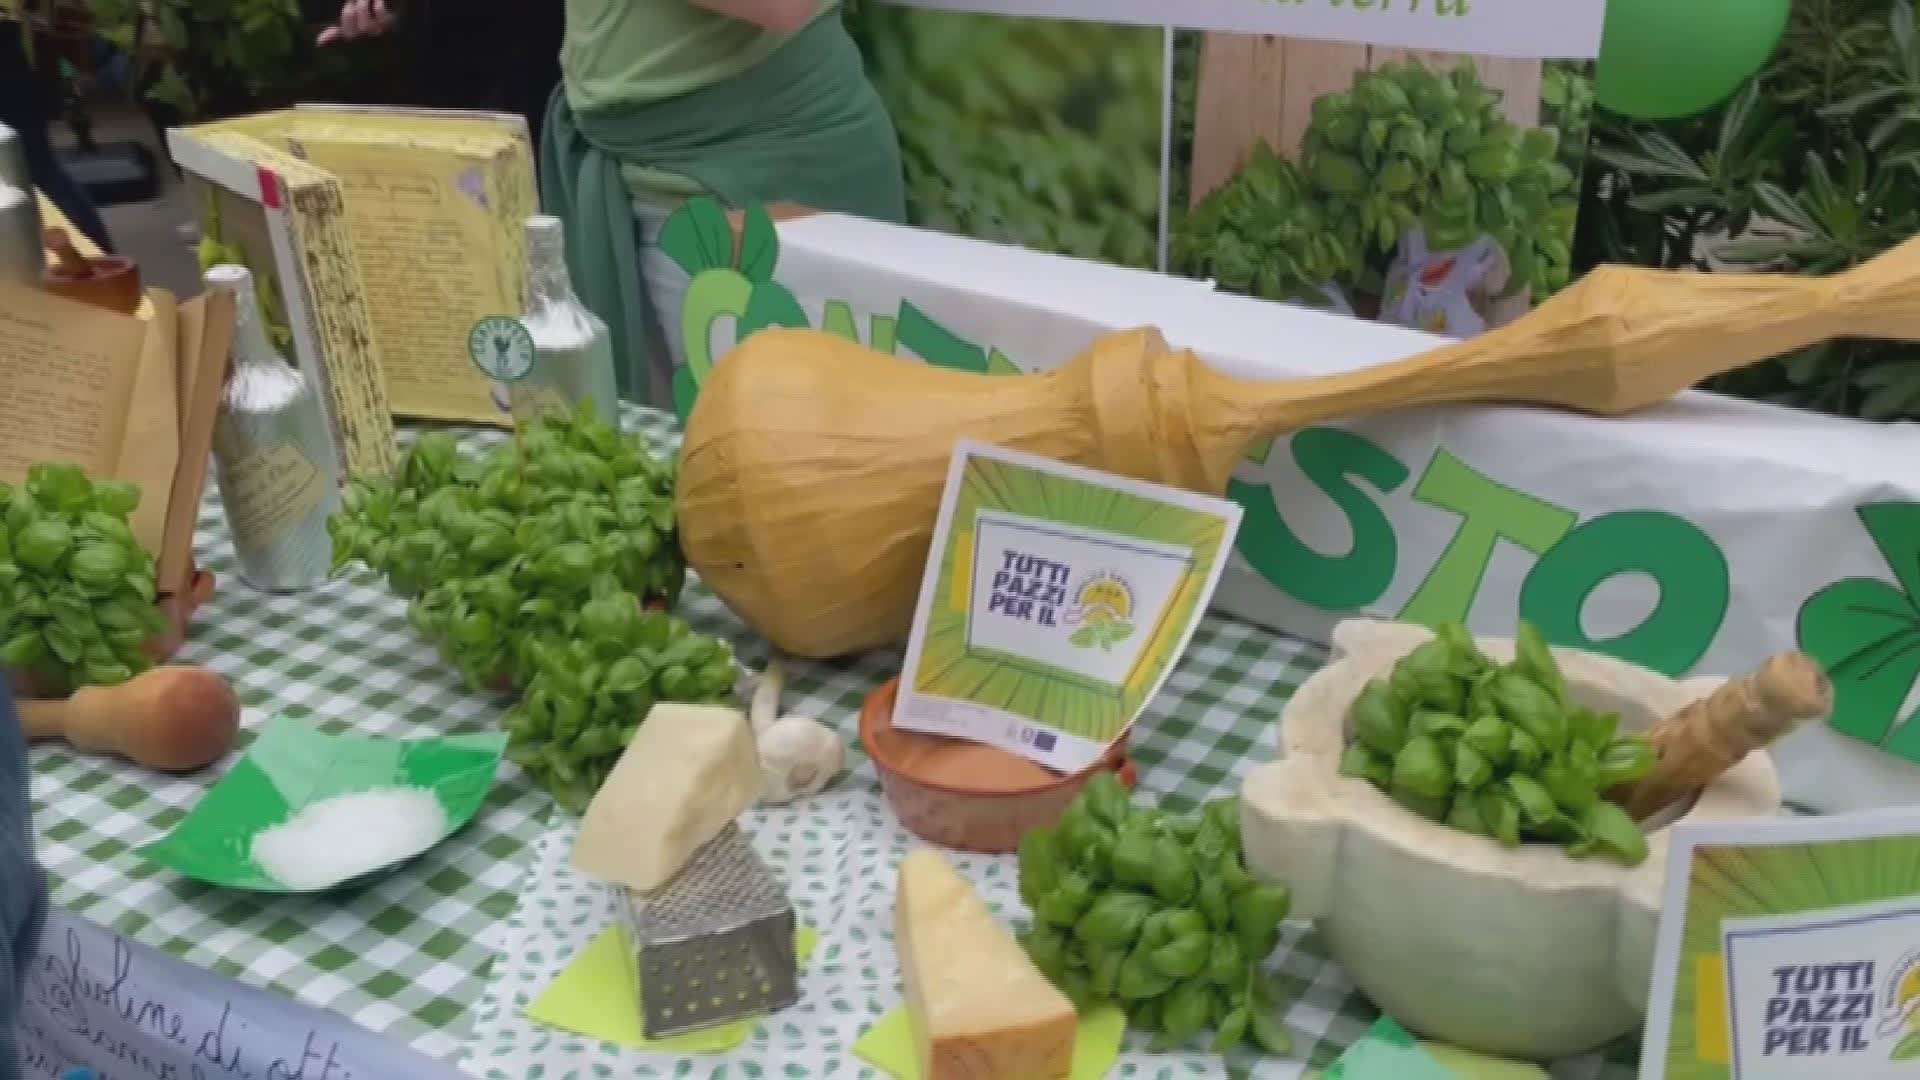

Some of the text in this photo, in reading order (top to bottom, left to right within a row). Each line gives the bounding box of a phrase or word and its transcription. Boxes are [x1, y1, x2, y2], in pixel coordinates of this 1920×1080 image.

[1003, 550, 1070, 585] TUTTI
[992, 571, 1066, 606] PAZZI
[988, 592, 1056, 627] PER IL
[1772, 960, 1875, 995] TUTTI
[1765, 993, 1874, 1026] PAZZI
[1762, 1024, 1870, 1056] PER IL
